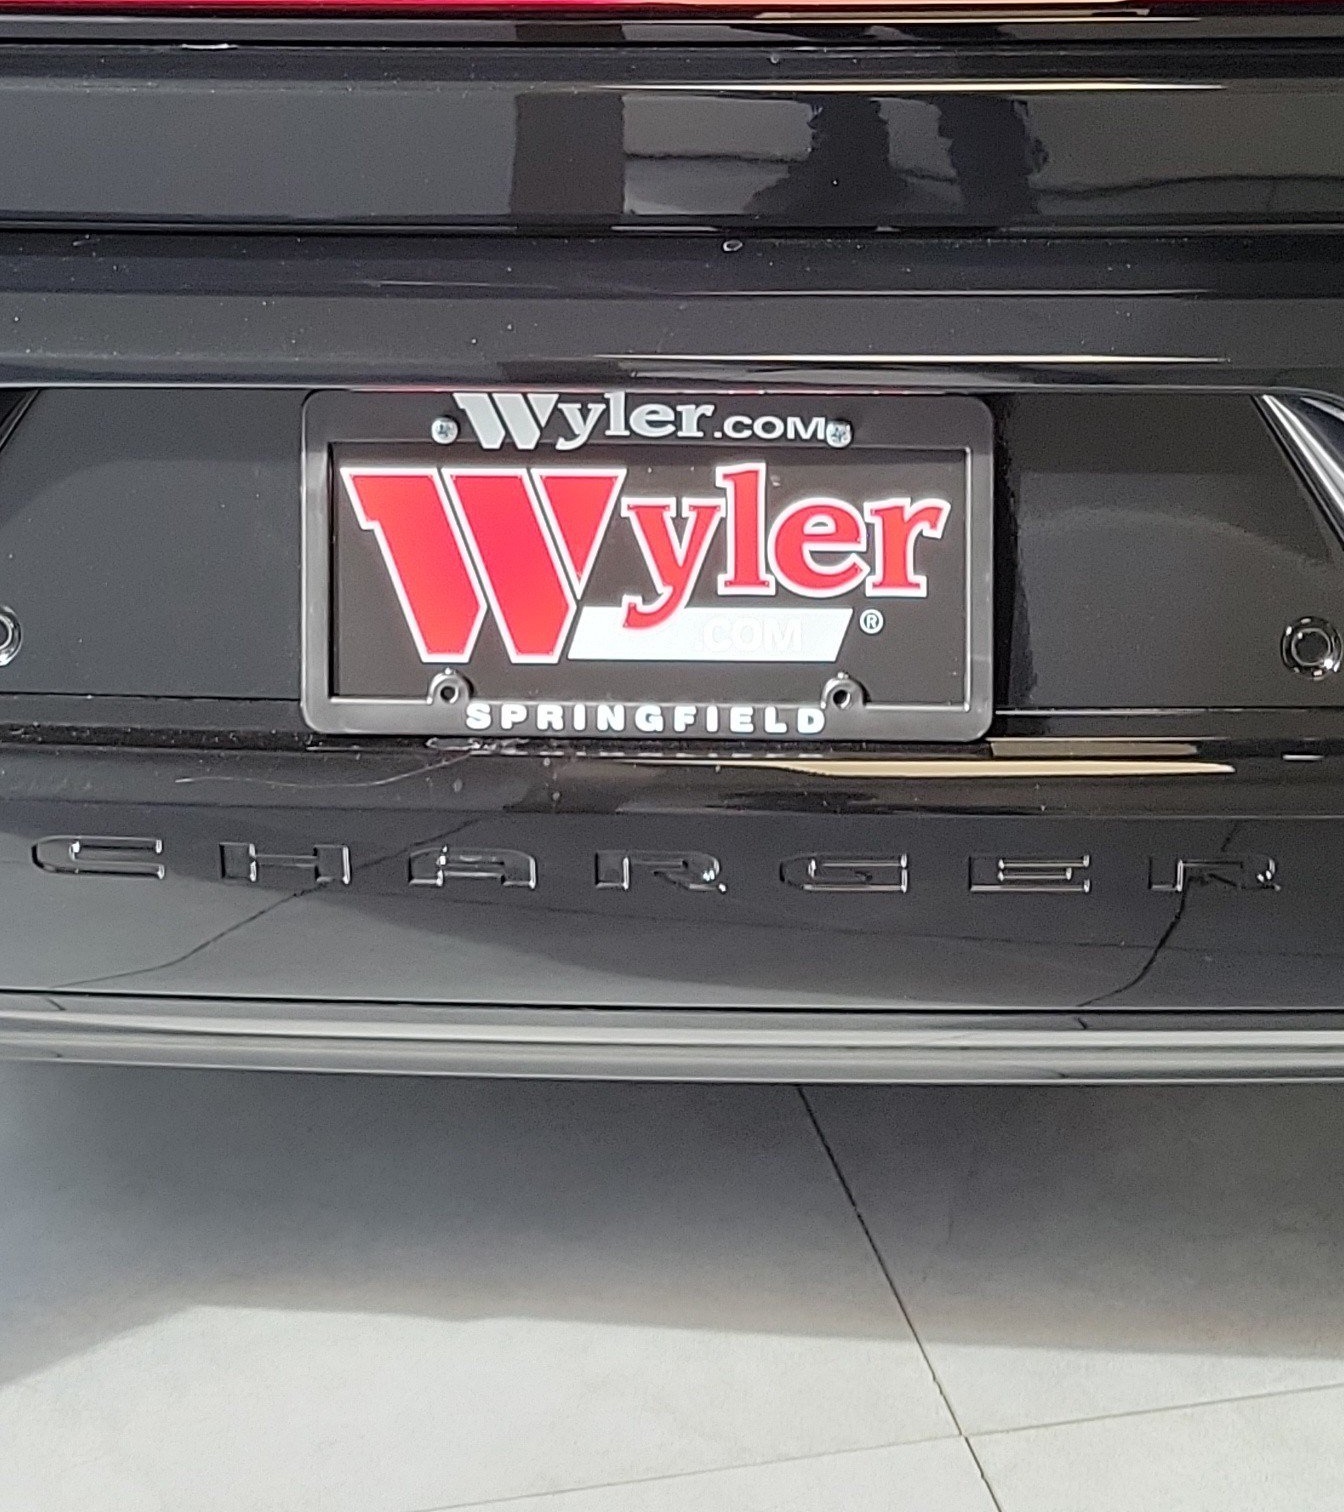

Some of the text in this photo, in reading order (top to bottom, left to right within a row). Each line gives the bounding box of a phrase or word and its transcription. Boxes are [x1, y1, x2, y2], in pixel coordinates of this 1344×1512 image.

[340, 462, 952, 664] Wyler
[465, 701, 827, 735] SPRINGFIELD
[31, 834, 1282, 895] CHARGER
